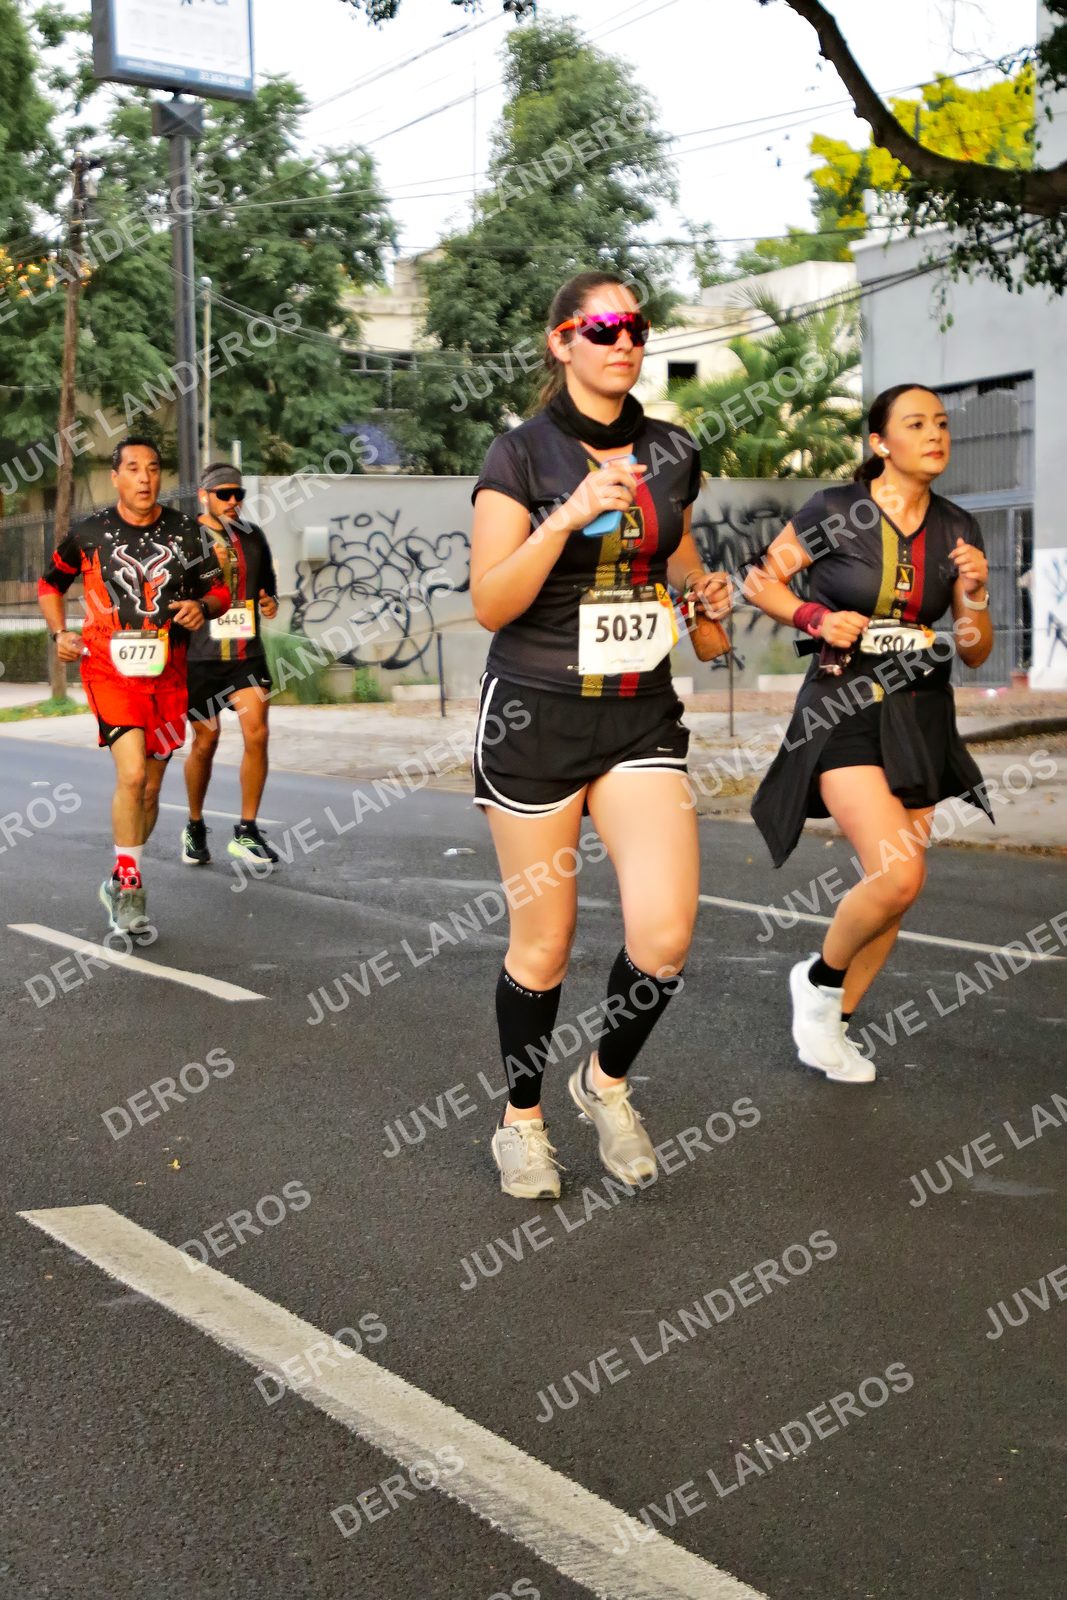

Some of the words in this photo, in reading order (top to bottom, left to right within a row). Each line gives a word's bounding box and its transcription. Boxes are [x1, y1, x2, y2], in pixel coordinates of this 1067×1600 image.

[330, 509, 401, 537] TOY
[216, 613, 246, 626] 6445
[595, 612, 658, 643] 5037
[118, 644, 157, 660] 6777
